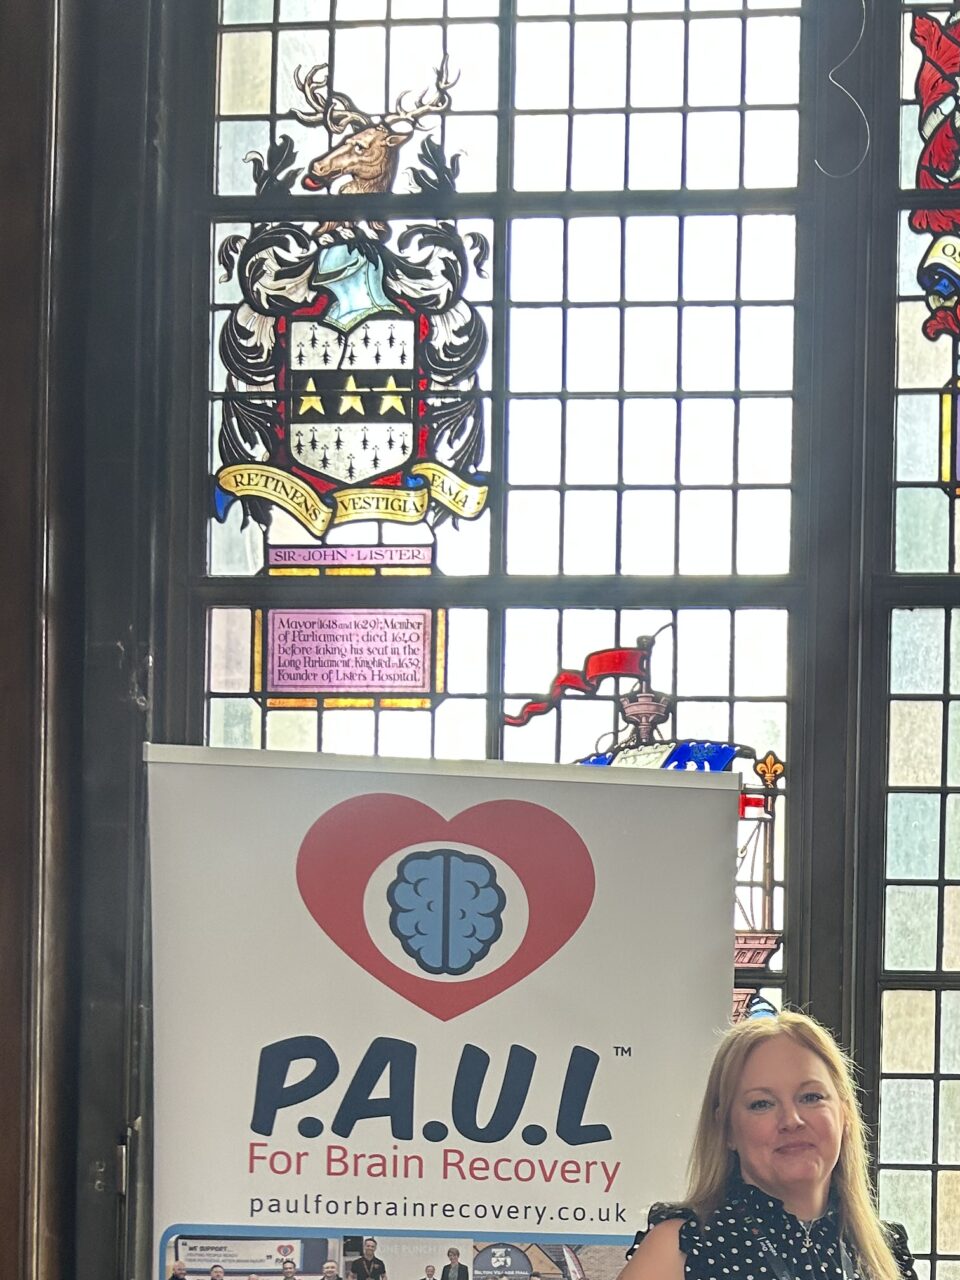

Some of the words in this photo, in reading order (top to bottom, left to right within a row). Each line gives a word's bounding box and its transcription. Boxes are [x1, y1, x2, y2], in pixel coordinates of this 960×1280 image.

[233, 473, 321, 522] RETINENS
[340, 497, 420, 513] VESTIGIA
[431, 473, 467, 508] FAMA
[274, 551, 296, 562] SIR
[303, 550, 347, 561] JOHN
[357, 550, 421, 560] LISTER
[278, 618, 316, 632] Mayor
[384, 618, 422, 629] Member
[278, 632, 290, 647] of
[361, 632, 387, 642] died
[278, 644, 312, 657] before
[315, 644, 346, 658] taking
[350, 644, 364, 655] his
[367, 644, 387, 655] seat
[391, 645, 400, 655] in
[403, 644, 420, 655] the
[278, 656, 301, 670] Long
[278, 669, 318, 681] Founder
[322, 670, 334, 683] of
[250, 1035, 612, 1146] P.A.U.L
[249, 1142, 308, 1176] For
[326, 1145, 424, 1179] Brain
[442, 1148, 621, 1192] Recovery
[250, 1194, 627, 1224] paulforbrainrecovery.co.uk
